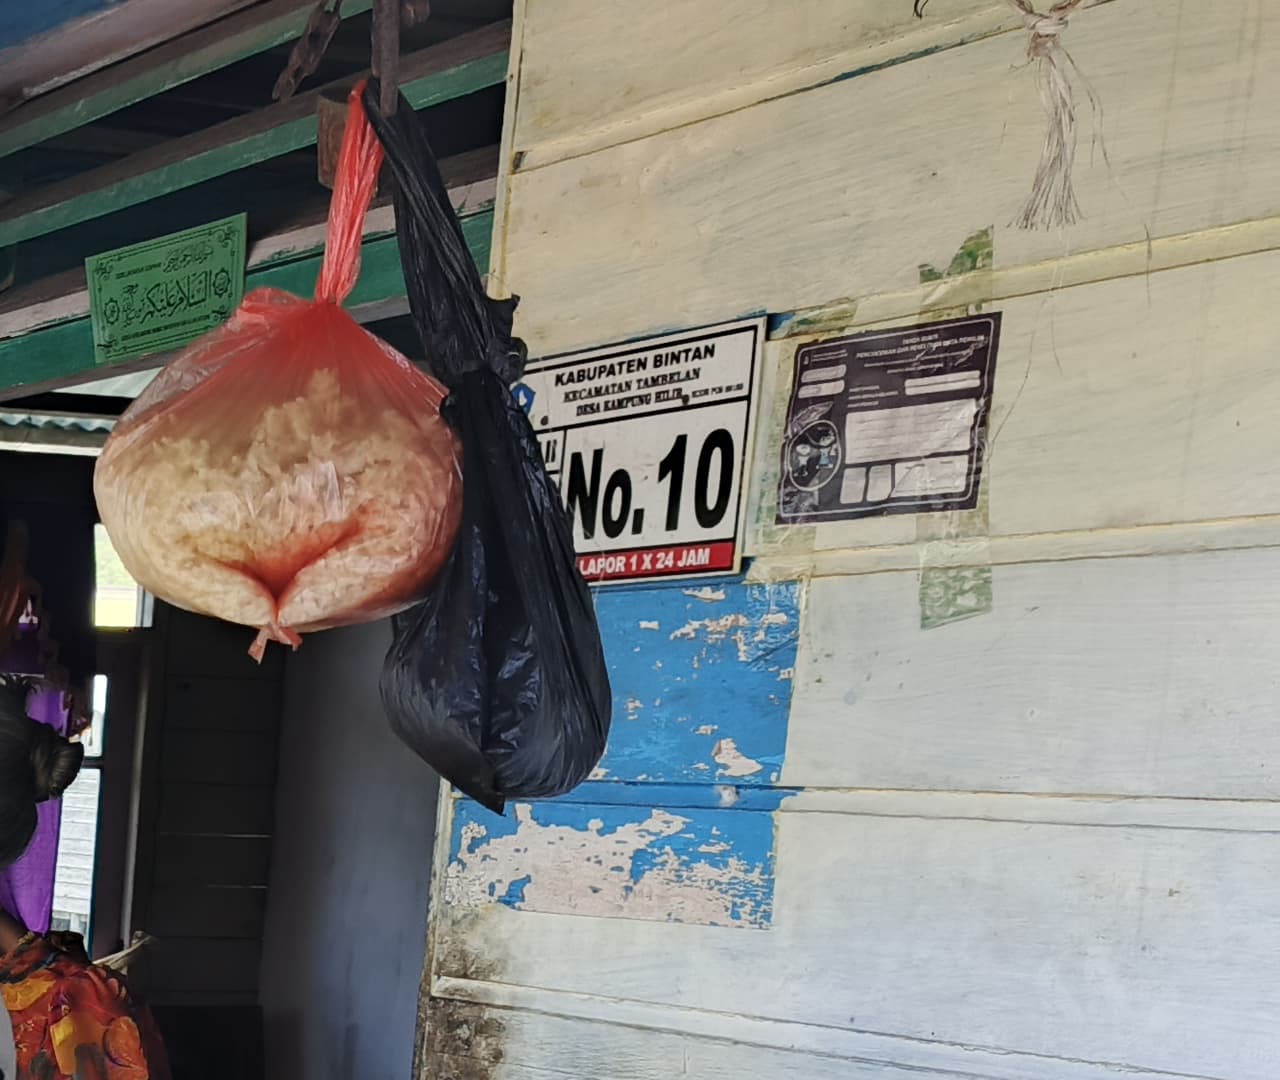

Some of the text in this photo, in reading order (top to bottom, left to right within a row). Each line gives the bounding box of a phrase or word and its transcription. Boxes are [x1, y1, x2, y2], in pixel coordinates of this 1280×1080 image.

[555, 344, 716, 387] KABUPATEN BINTAN
[563, 380, 633, 404] KECAMATAN
[636, 368, 702, 389] TAMBELAN
[576, 401, 601, 417] DESA
[603, 393, 652, 412] KAMPUNG
[566, 447, 645, 539] No.
[657, 428, 735, 533] 10
[579, 548, 711, 576] LAPOR 1 X 24 JAM
